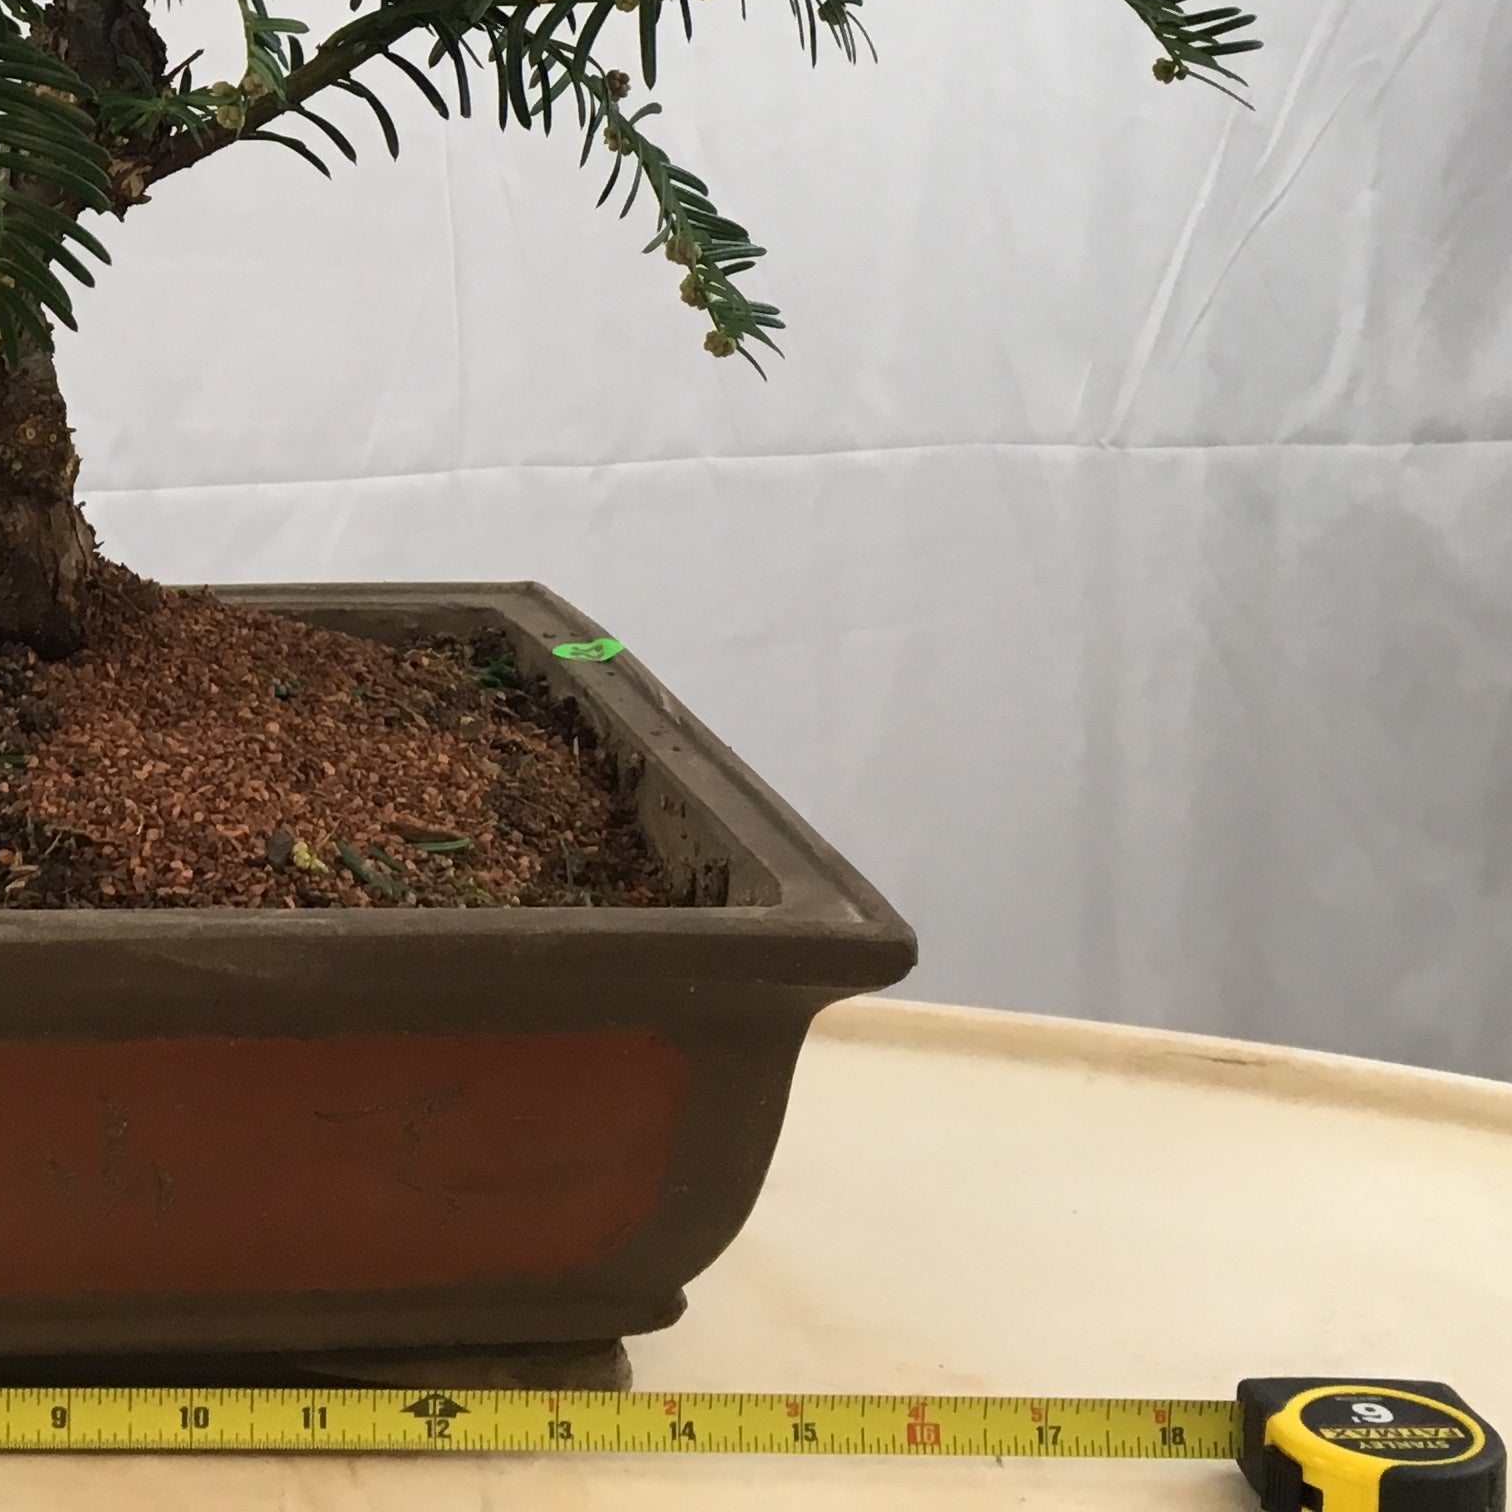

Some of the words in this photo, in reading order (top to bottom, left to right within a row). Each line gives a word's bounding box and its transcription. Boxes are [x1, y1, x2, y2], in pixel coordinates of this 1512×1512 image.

[548, 1397, 555, 1413] 1
[664, 1399, 677, 1416] 2
[785, 1401, 799, 1418] 3
[1031, 1404, 1043, 1423] 5
[1154, 1408, 1166, 1424] 6
[1351, 1402, 1394, 1423] 6'
[50, 1406, 67, 1430] 9
[179, 1406, 210, 1430] 10
[301, 1406, 328, 1430] 11
[425, 1419, 452, 1439] 12
[548, 1420, 574, 1440] 13
[669, 1420, 696, 1441] 14
[791, 1421, 817, 1442] 15
[914, 1425, 936, 1443] 16
[1036, 1425, 1062, 1446] 17
[1159, 1426, 1185, 1446] 18
[1318, 1426, 1466, 1439] FATMAX
[1359, 1440, 1449, 1450] STANLEY
